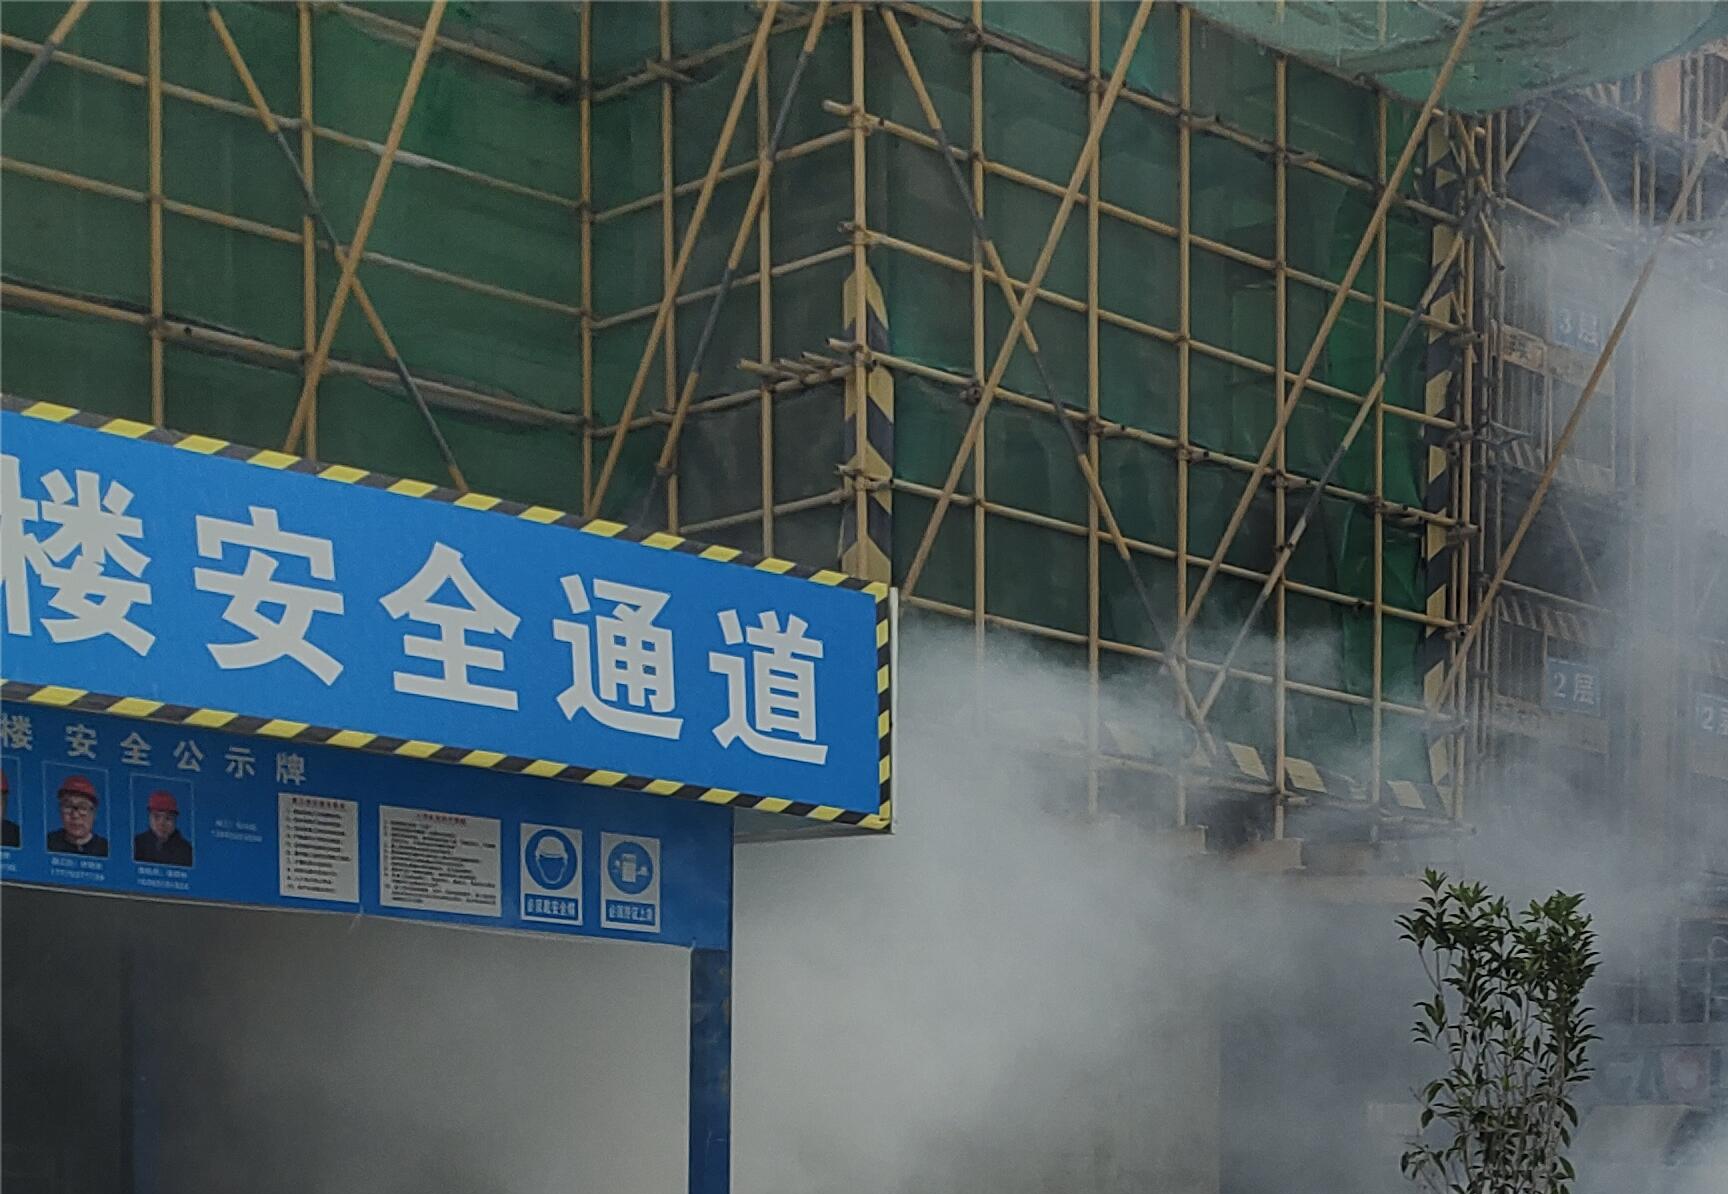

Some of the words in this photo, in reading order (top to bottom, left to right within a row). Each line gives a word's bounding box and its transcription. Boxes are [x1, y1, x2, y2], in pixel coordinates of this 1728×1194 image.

[0, 453, 829, 766] 楼安全通道
[1552, 670, 1596, 708] 2层
[0, 713, 307, 786] 楼安全公示牌
